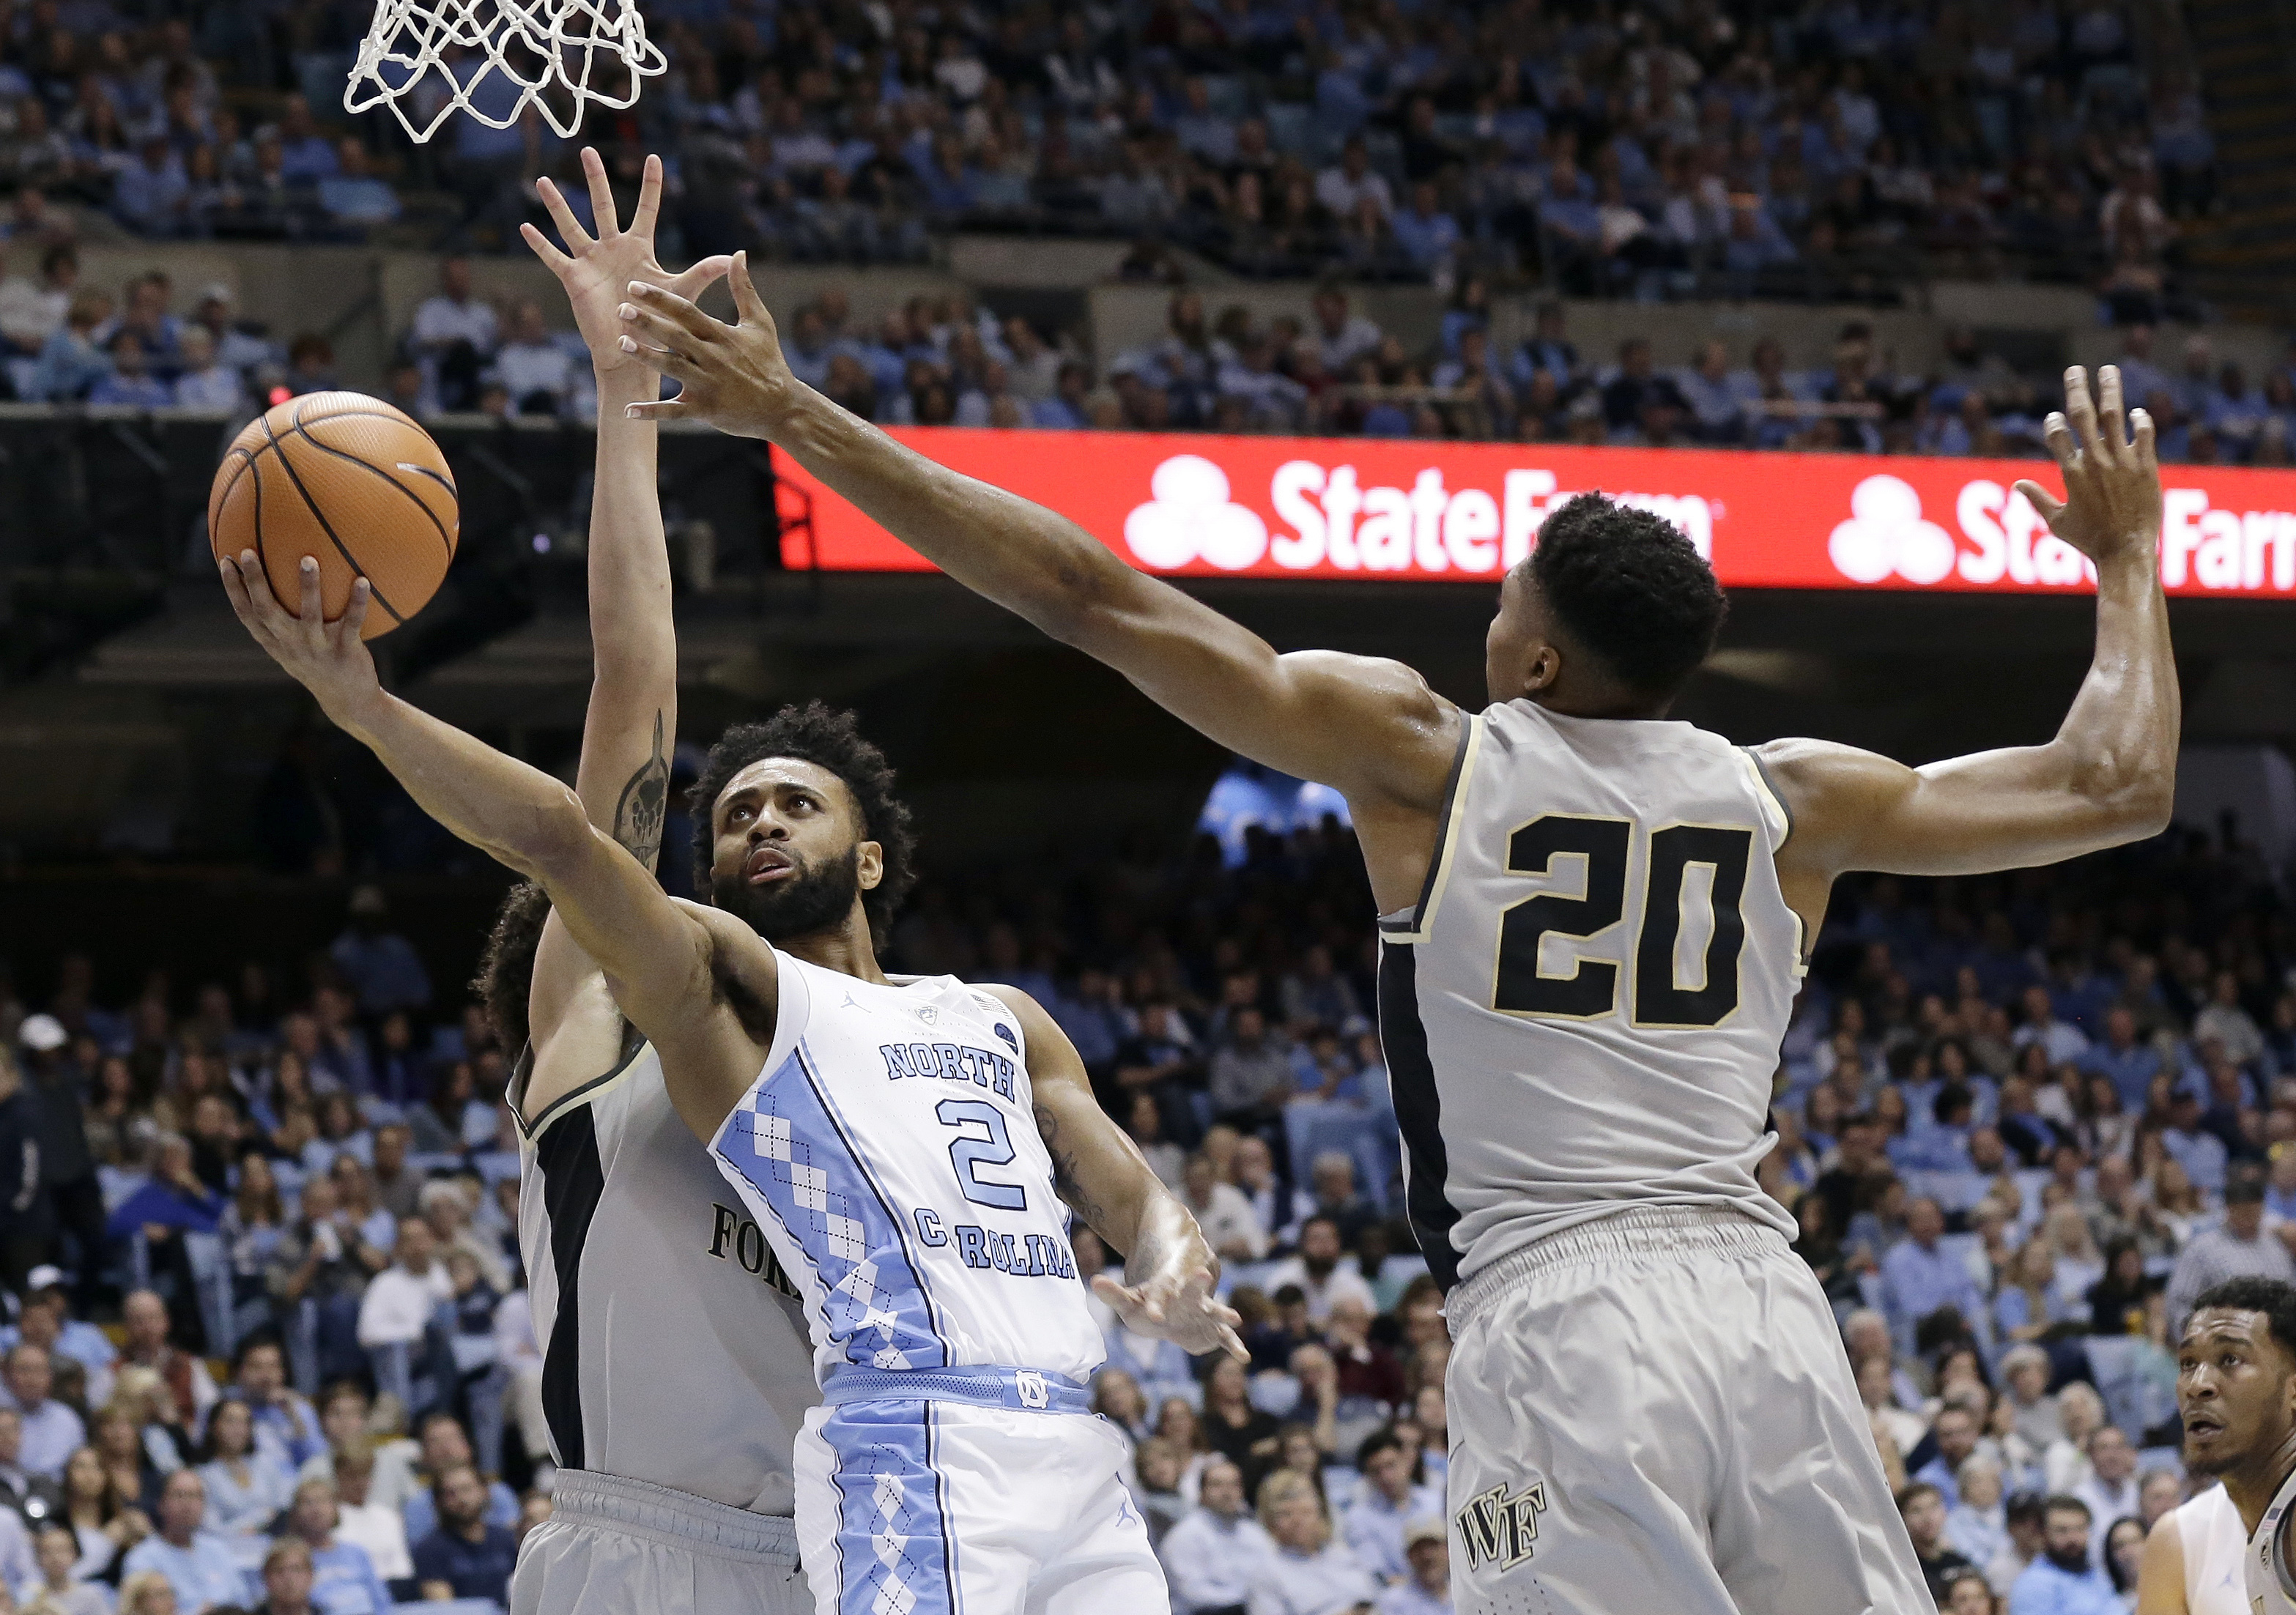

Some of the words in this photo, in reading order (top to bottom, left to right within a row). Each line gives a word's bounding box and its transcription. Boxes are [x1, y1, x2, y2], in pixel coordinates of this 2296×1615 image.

[1490, 812, 1758, 1030] 20
[879, 1043, 1015, 1104] NORTH
[935, 1099, 1027, 1211] 2
[708, 1202, 804, 1302] FOR
[914, 1208, 1075, 1280] CROLINA
[1455, 1481, 1547, 1573] WF
